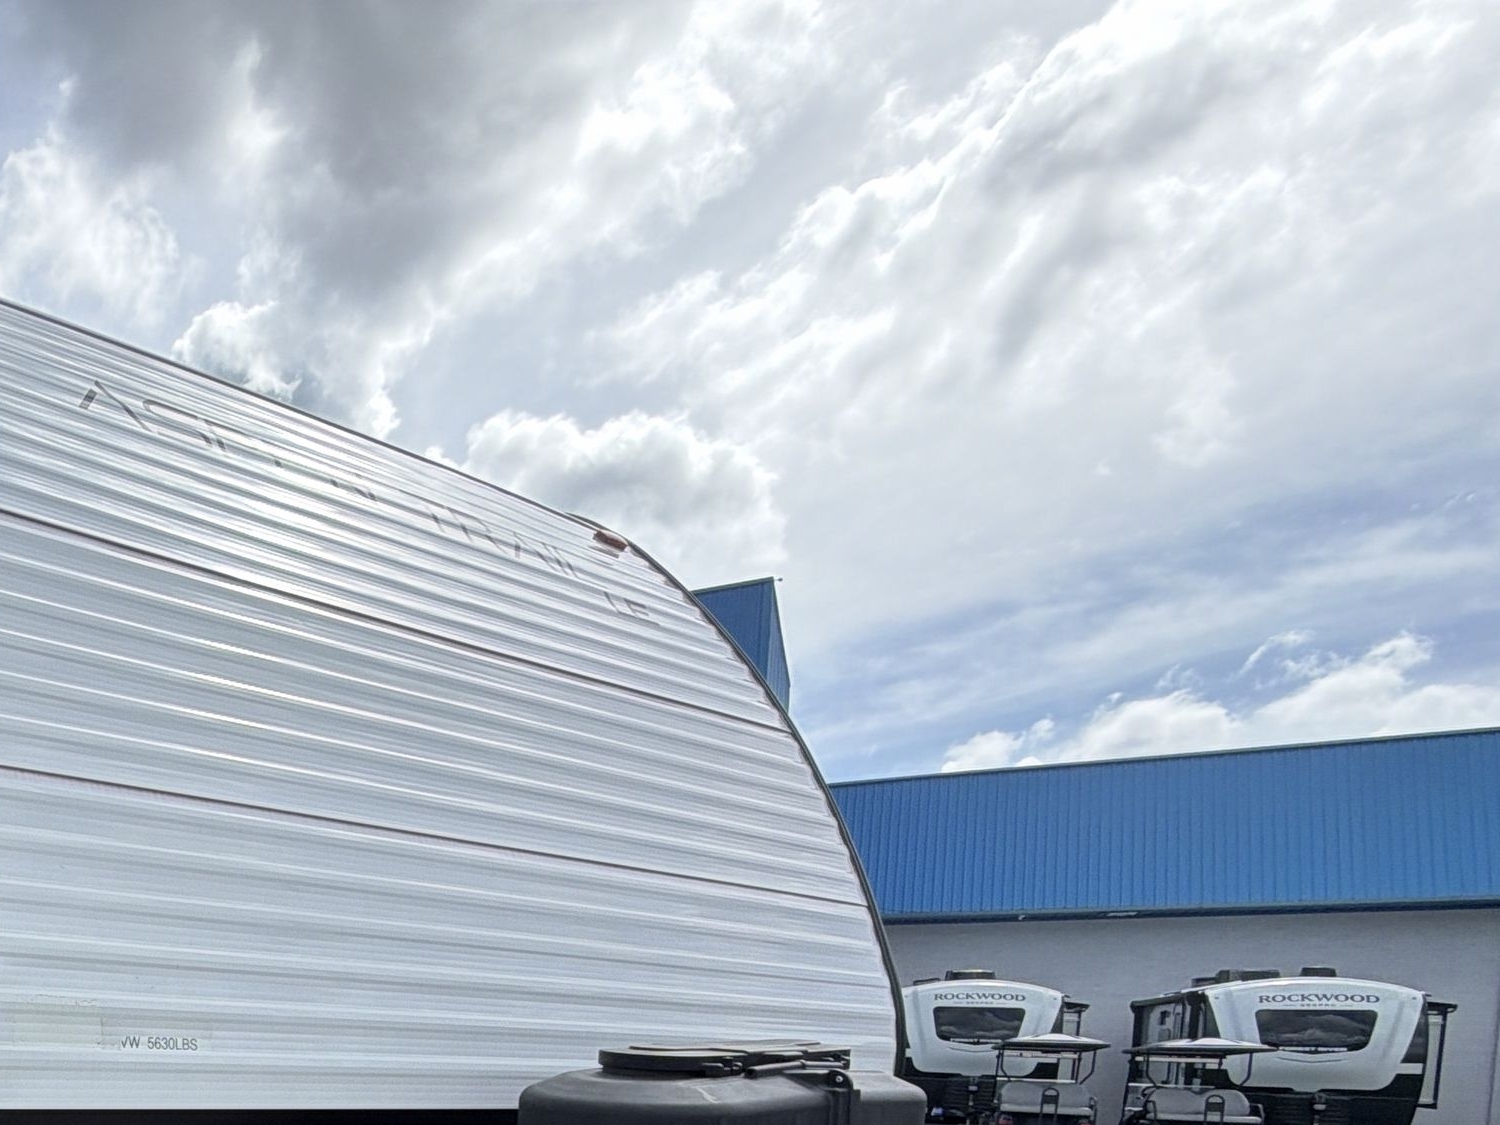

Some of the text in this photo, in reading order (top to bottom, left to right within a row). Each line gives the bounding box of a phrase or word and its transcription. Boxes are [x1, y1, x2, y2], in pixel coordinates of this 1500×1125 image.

[934, 992, 1026, 1001] ROCKWOOD
[1258, 993, 1380, 1004] ROCKWOOD
[147, 1036, 198, 1051] 5630LBS
